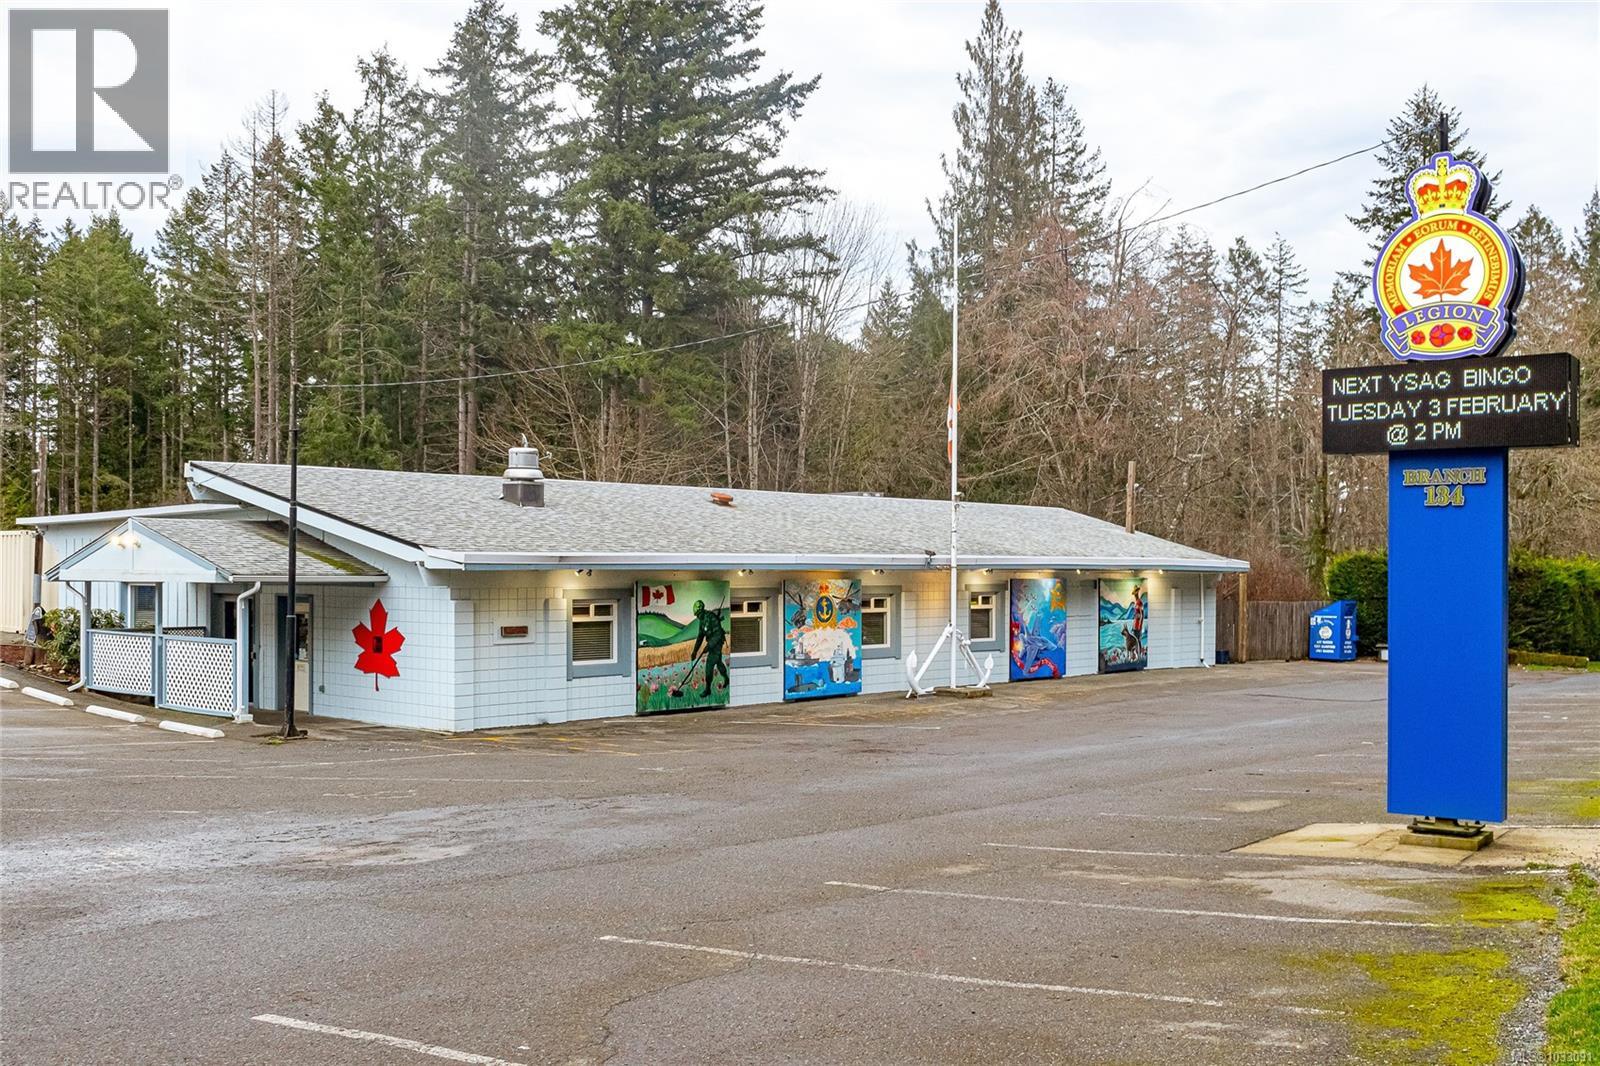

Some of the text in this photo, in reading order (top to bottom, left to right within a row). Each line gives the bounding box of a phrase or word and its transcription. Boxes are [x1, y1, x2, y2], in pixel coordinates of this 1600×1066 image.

[1385, 220, 1501, 309] MEMORIAM EORUM RETINEBIMUS
[1402, 304, 1484, 328] LEGION
[1332, 365, 1531, 395] NEXT YSAG BINGO
[1327, 391, 1566, 422] TUESDAY 3 FEBRUARY
[1387, 421, 1462, 446] @ 2 PM
[1403, 467, 1486, 486] BRANCH
[1424, 486, 1465, 507] 134
